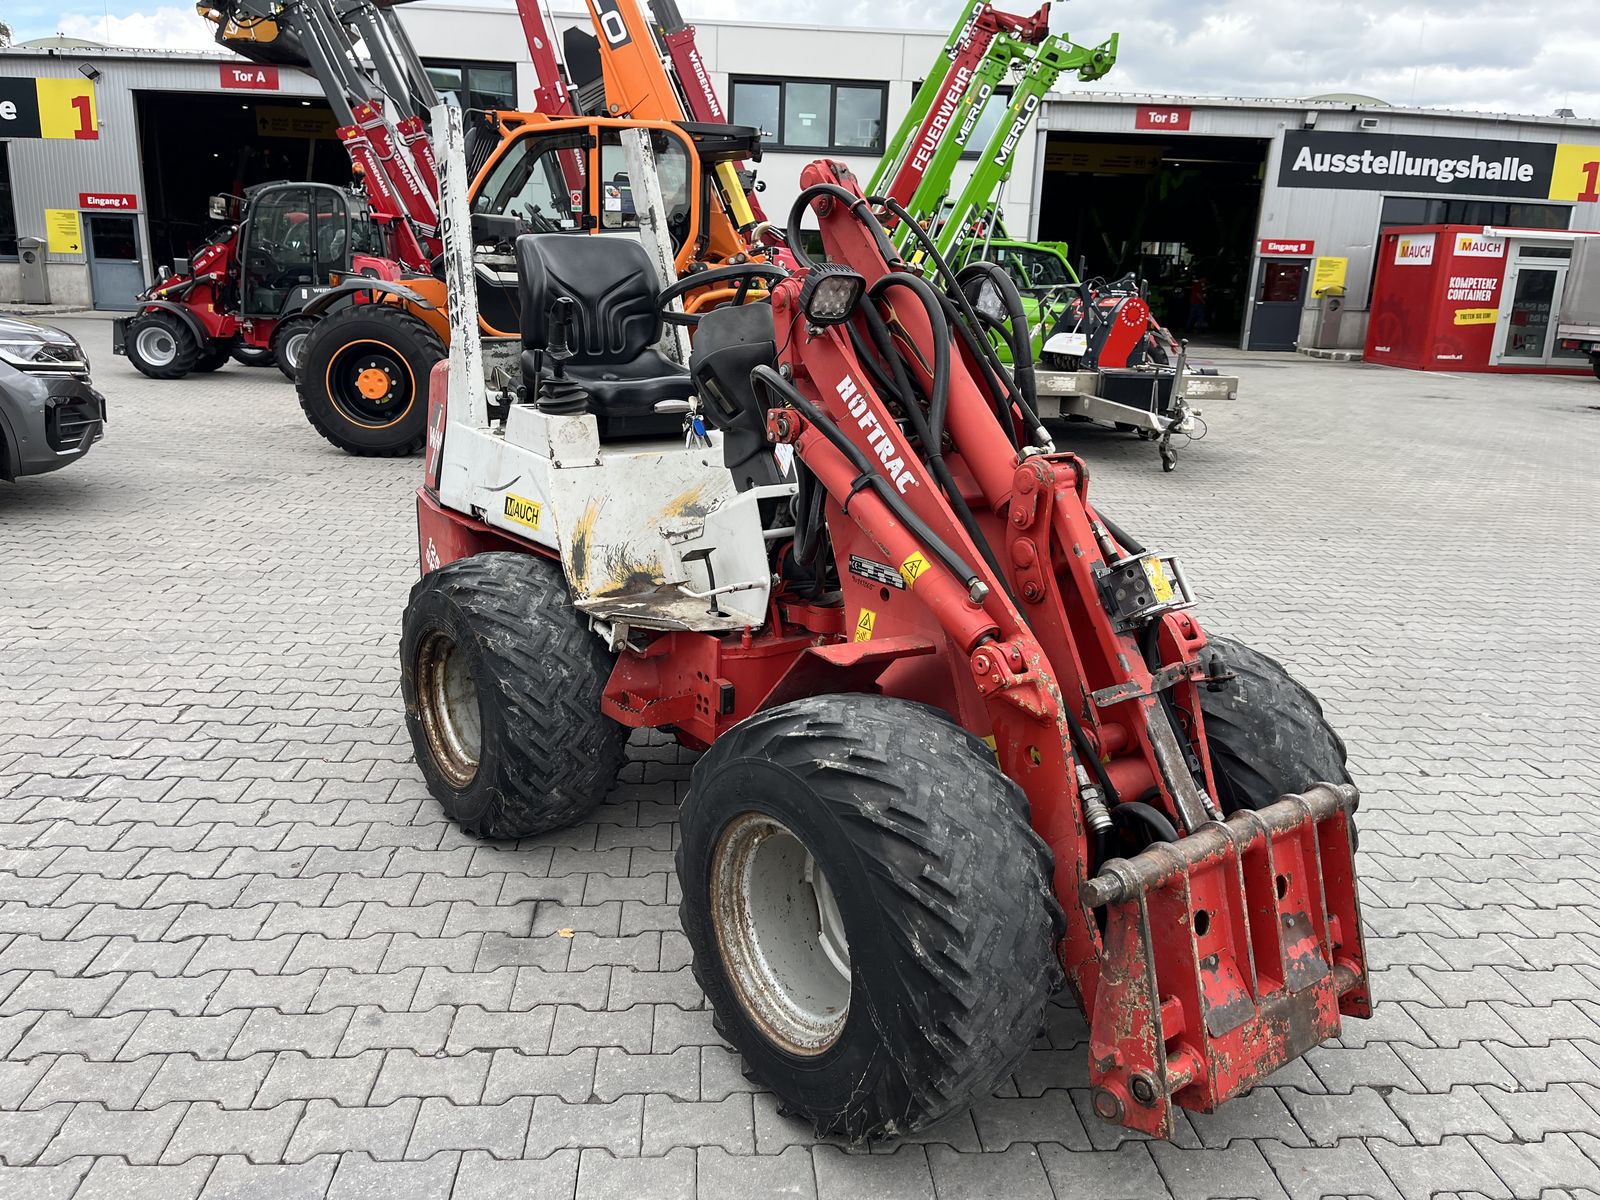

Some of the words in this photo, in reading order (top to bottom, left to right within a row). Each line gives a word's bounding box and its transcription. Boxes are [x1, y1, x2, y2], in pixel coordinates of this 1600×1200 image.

[232, 70, 253, 81] Tor
[256, 71, 266, 82] A
[688, 50, 721, 118] WEIDEMANN
[71, 96, 99, 139] 1
[911, 66, 971, 171] FEUERWEHR
[954, 84, 991, 146] MERLO
[1148, 111, 1167, 123] Tor
[1170, 112, 1179, 123] B
[993, 94, 1039, 167] MERLO
[364, 149, 390, 198] WEIDEMANN
[383, 133, 420, 195] WEDEMANN
[1292, 146, 1534, 183] Ausstellungshalle
[1577, 161, 1599, 202] 1
[87, 196, 120, 207] Eingang
[122, 197, 129, 206] A
[437, 158, 460, 328] WEIDEMANN
[955, 221, 971, 246] 27.6
[1267, 242, 1299, 252] Eingang
[1461, 240, 1501, 253] MAUCH
[1401, 245, 1432, 259] MAUCH
[1447, 289, 1492, 302] CONTAINER
[1449, 277, 1498, 290] KOMPETENZ
[504, 495, 540, 525] MAUCH
